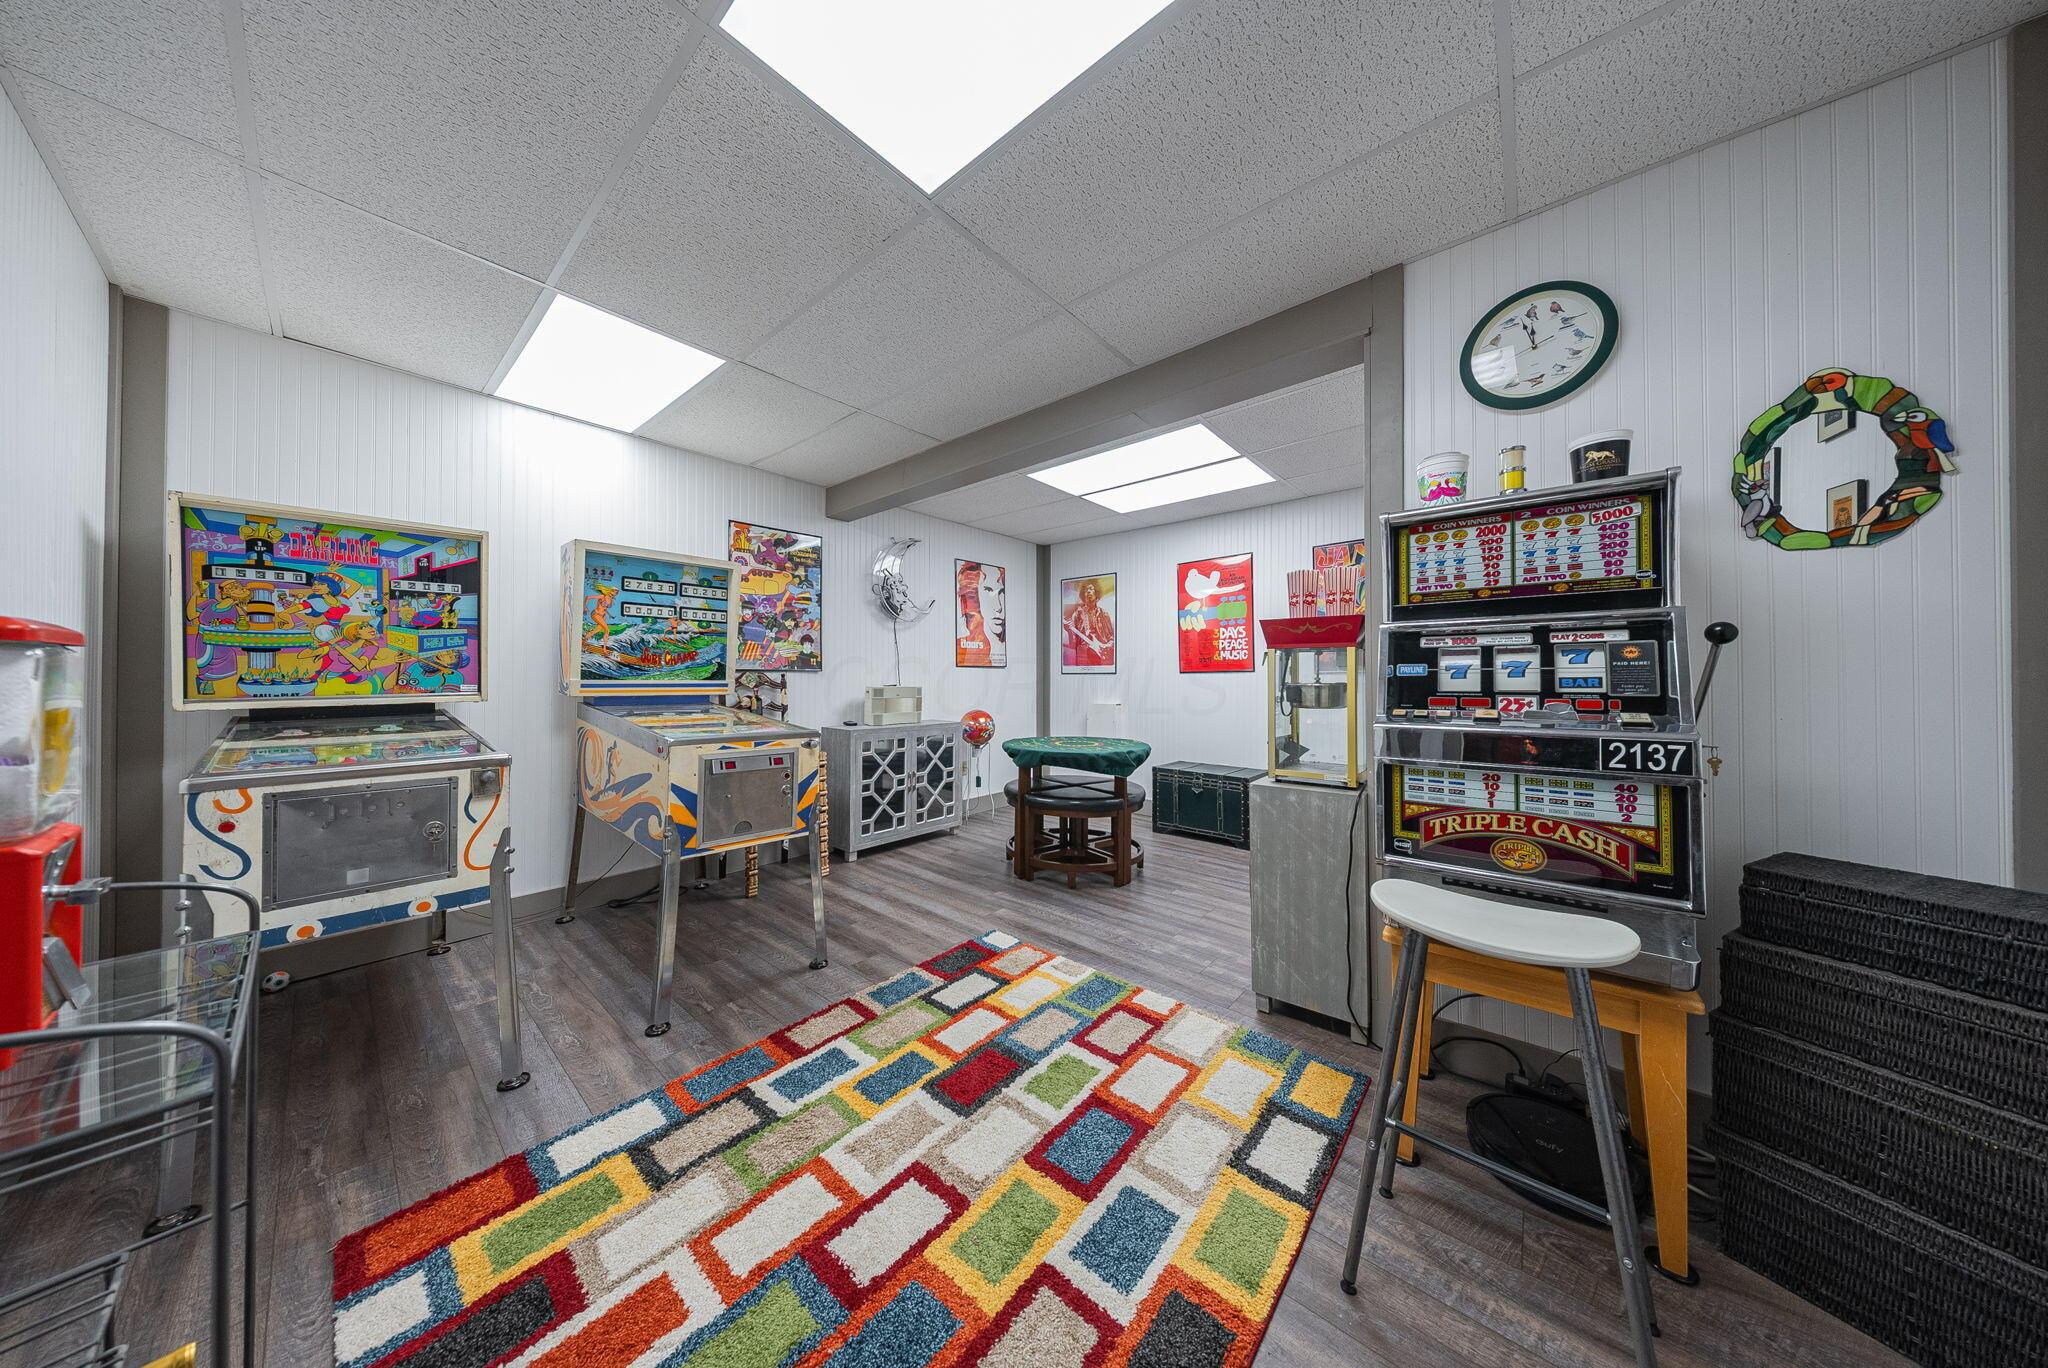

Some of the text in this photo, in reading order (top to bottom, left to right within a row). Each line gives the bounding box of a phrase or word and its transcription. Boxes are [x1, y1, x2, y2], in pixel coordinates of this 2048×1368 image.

[1547, 505, 1575, 515] COIN
[1578, 497, 1630, 510] WINNERS
[1433, 520, 1456, 530] COIN
[1458, 515, 1502, 526] WINNERS
[1597, 521, 1630, 532] 400
[1475, 524, 1507, 538] 2000
[1479, 537, 1504, 546] 200
[1599, 540, 1629, 551] 200
[288, 532, 380, 565] DARLING
[1600, 549, 1628, 559] 100
[1481, 553, 1504, 562] 100
[1522, 575, 1542, 583] ANY
[1543, 573, 1567, 581] TWO
[1213, 626, 1246, 639] 3 DAYS
[1571, 633, 1579, 642] 2
[1219, 638, 1248, 650] PEACE
[1213, 651, 1222, 660] &
[1220, 650, 1248, 660] MUSIC
[1561, 648, 1596, 664] 7
[1400, 665, 1425, 674] PAYLINE
[1445, 664, 1473, 679] 7
[1502, 660, 1532, 678] 7
[1561, 678, 1600, 688] BAR
[1499, 697, 1534, 713] 25¢
[1608, 742, 1687, 772] 2137
[1482, 773, 1501, 782] 20
[1483, 782, 1500, 791] 10
[1614, 783, 1639, 794] 40
[1615, 793, 1638, 804] 20
[1616, 803, 1637, 813] 10
[1621, 813, 1632, 823] 2
[1429, 814, 1620, 864] TRIPLE CASH
[1503, 843, 1535, 853] TRIPLE
[1497, 850, 1542, 864] CASH
[1536, 1139, 1564, 1153] eufy
